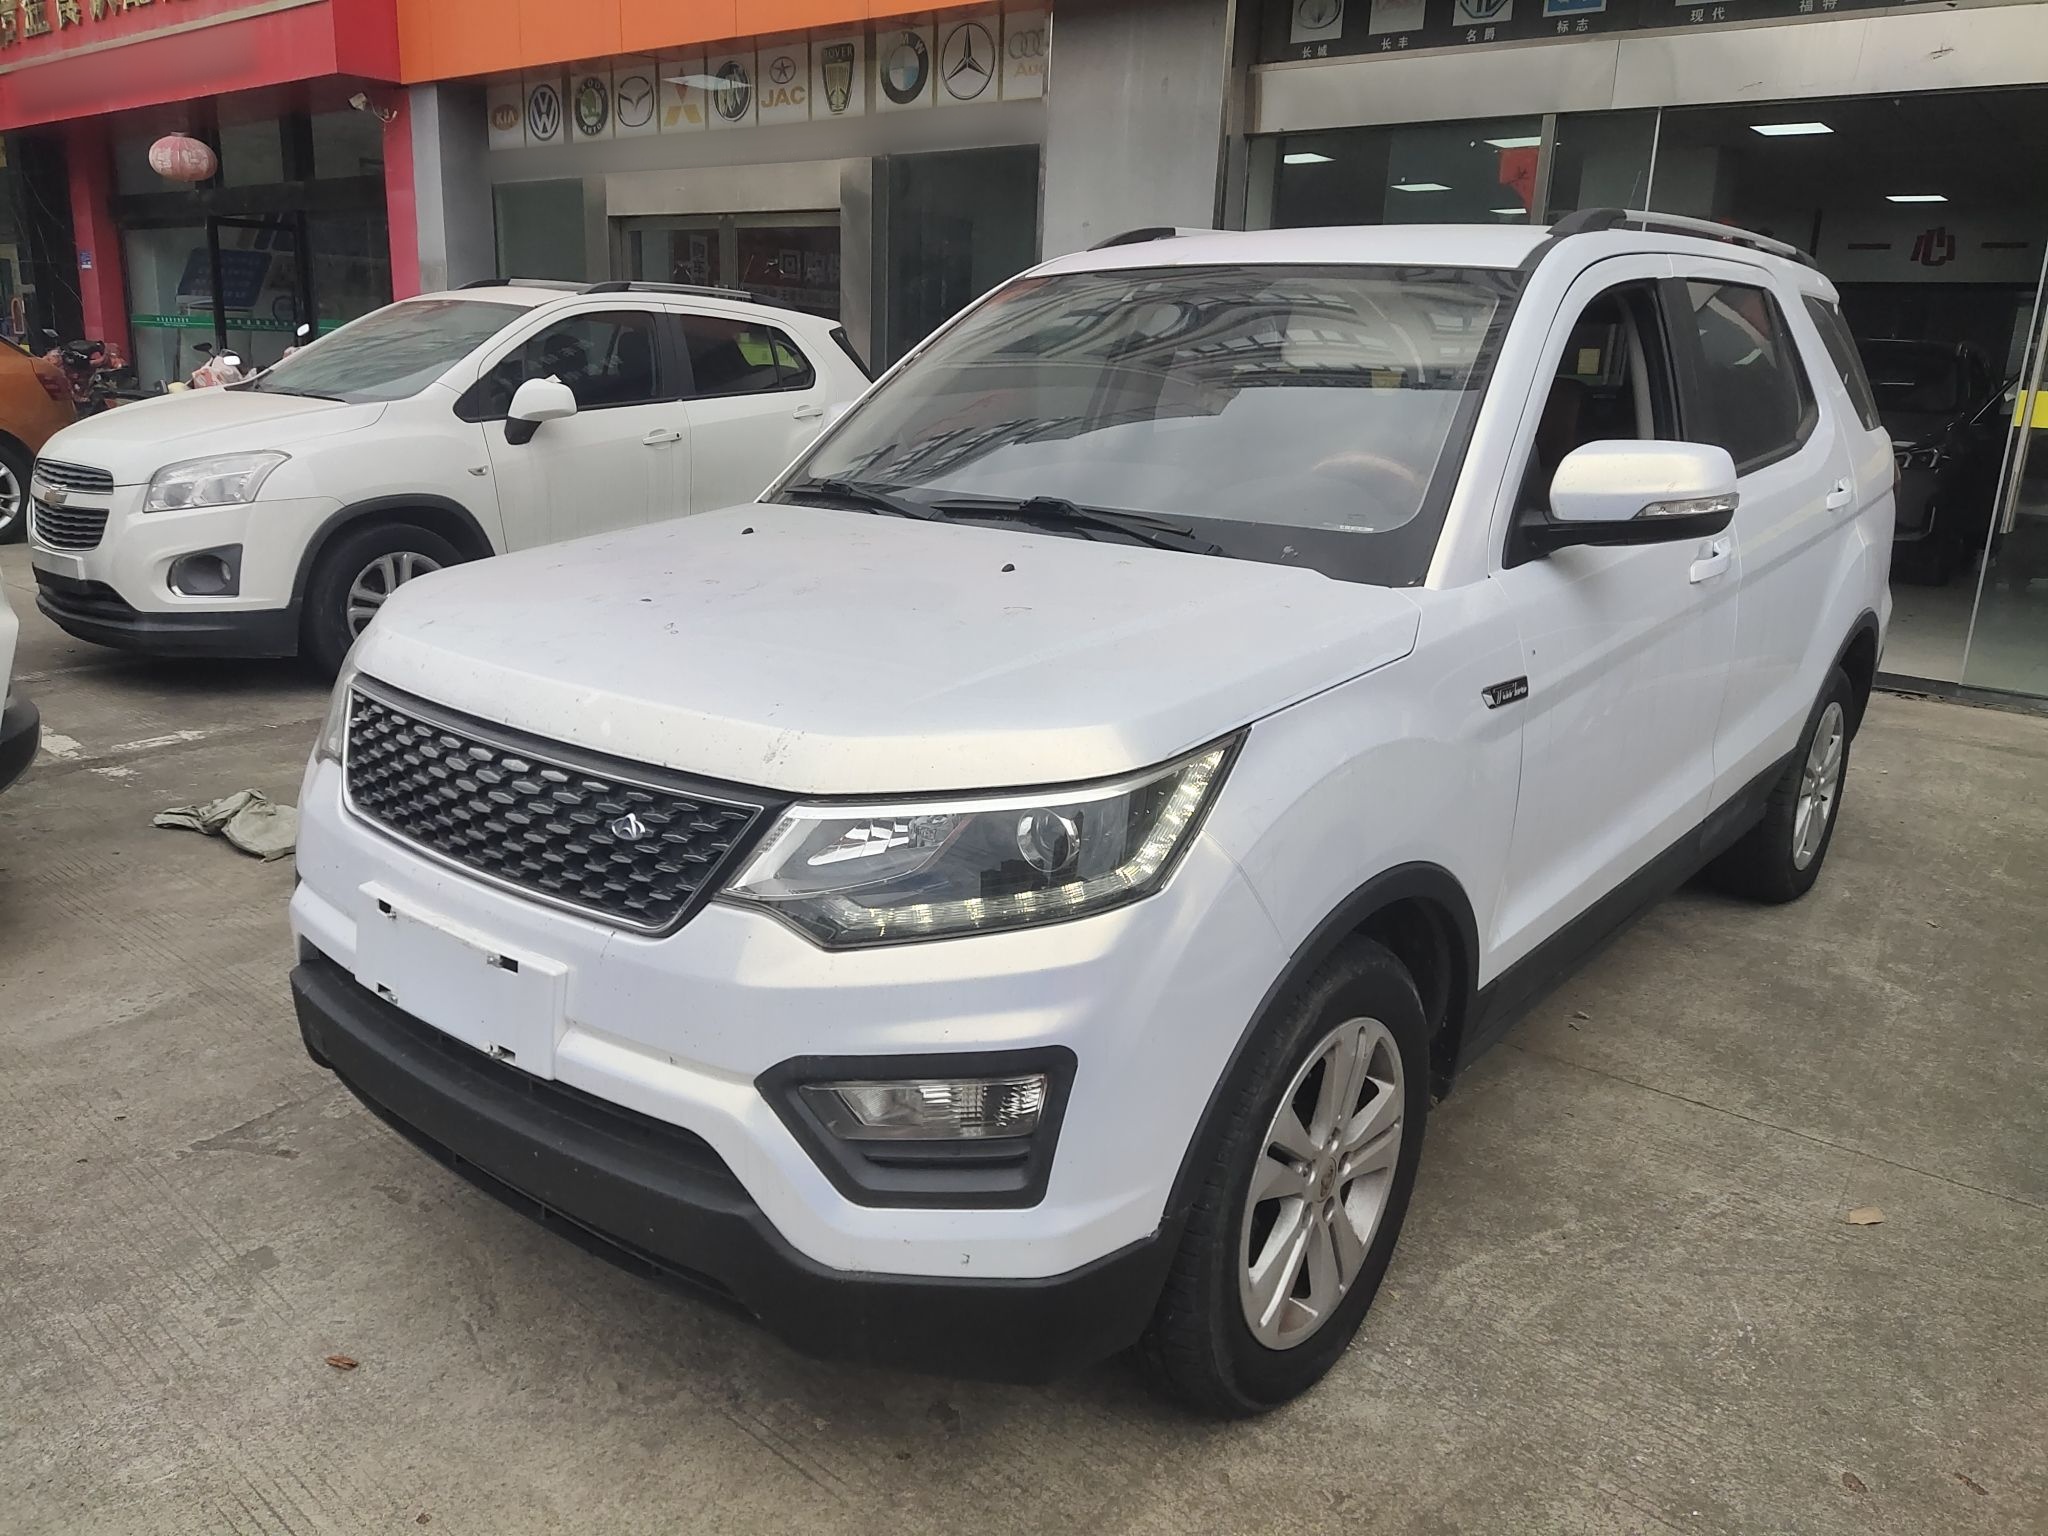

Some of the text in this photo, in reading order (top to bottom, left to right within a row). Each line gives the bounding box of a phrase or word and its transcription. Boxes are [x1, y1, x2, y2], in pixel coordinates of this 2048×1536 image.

[1690, 7, 1726, 24] 现代
[1557, 18, 1590, 33] 标志
[1465, 27, 1496, 42] 名爵
[1381, 35, 1409, 50] 长丰
[1302, 44, 1328, 59] 长城
[761, 86, 805, 108] JAC
[495, 110, 515, 125] KIA
[582, 123, 601, 134] AUTO
[1492, 681, 1527, 704] Turbo
